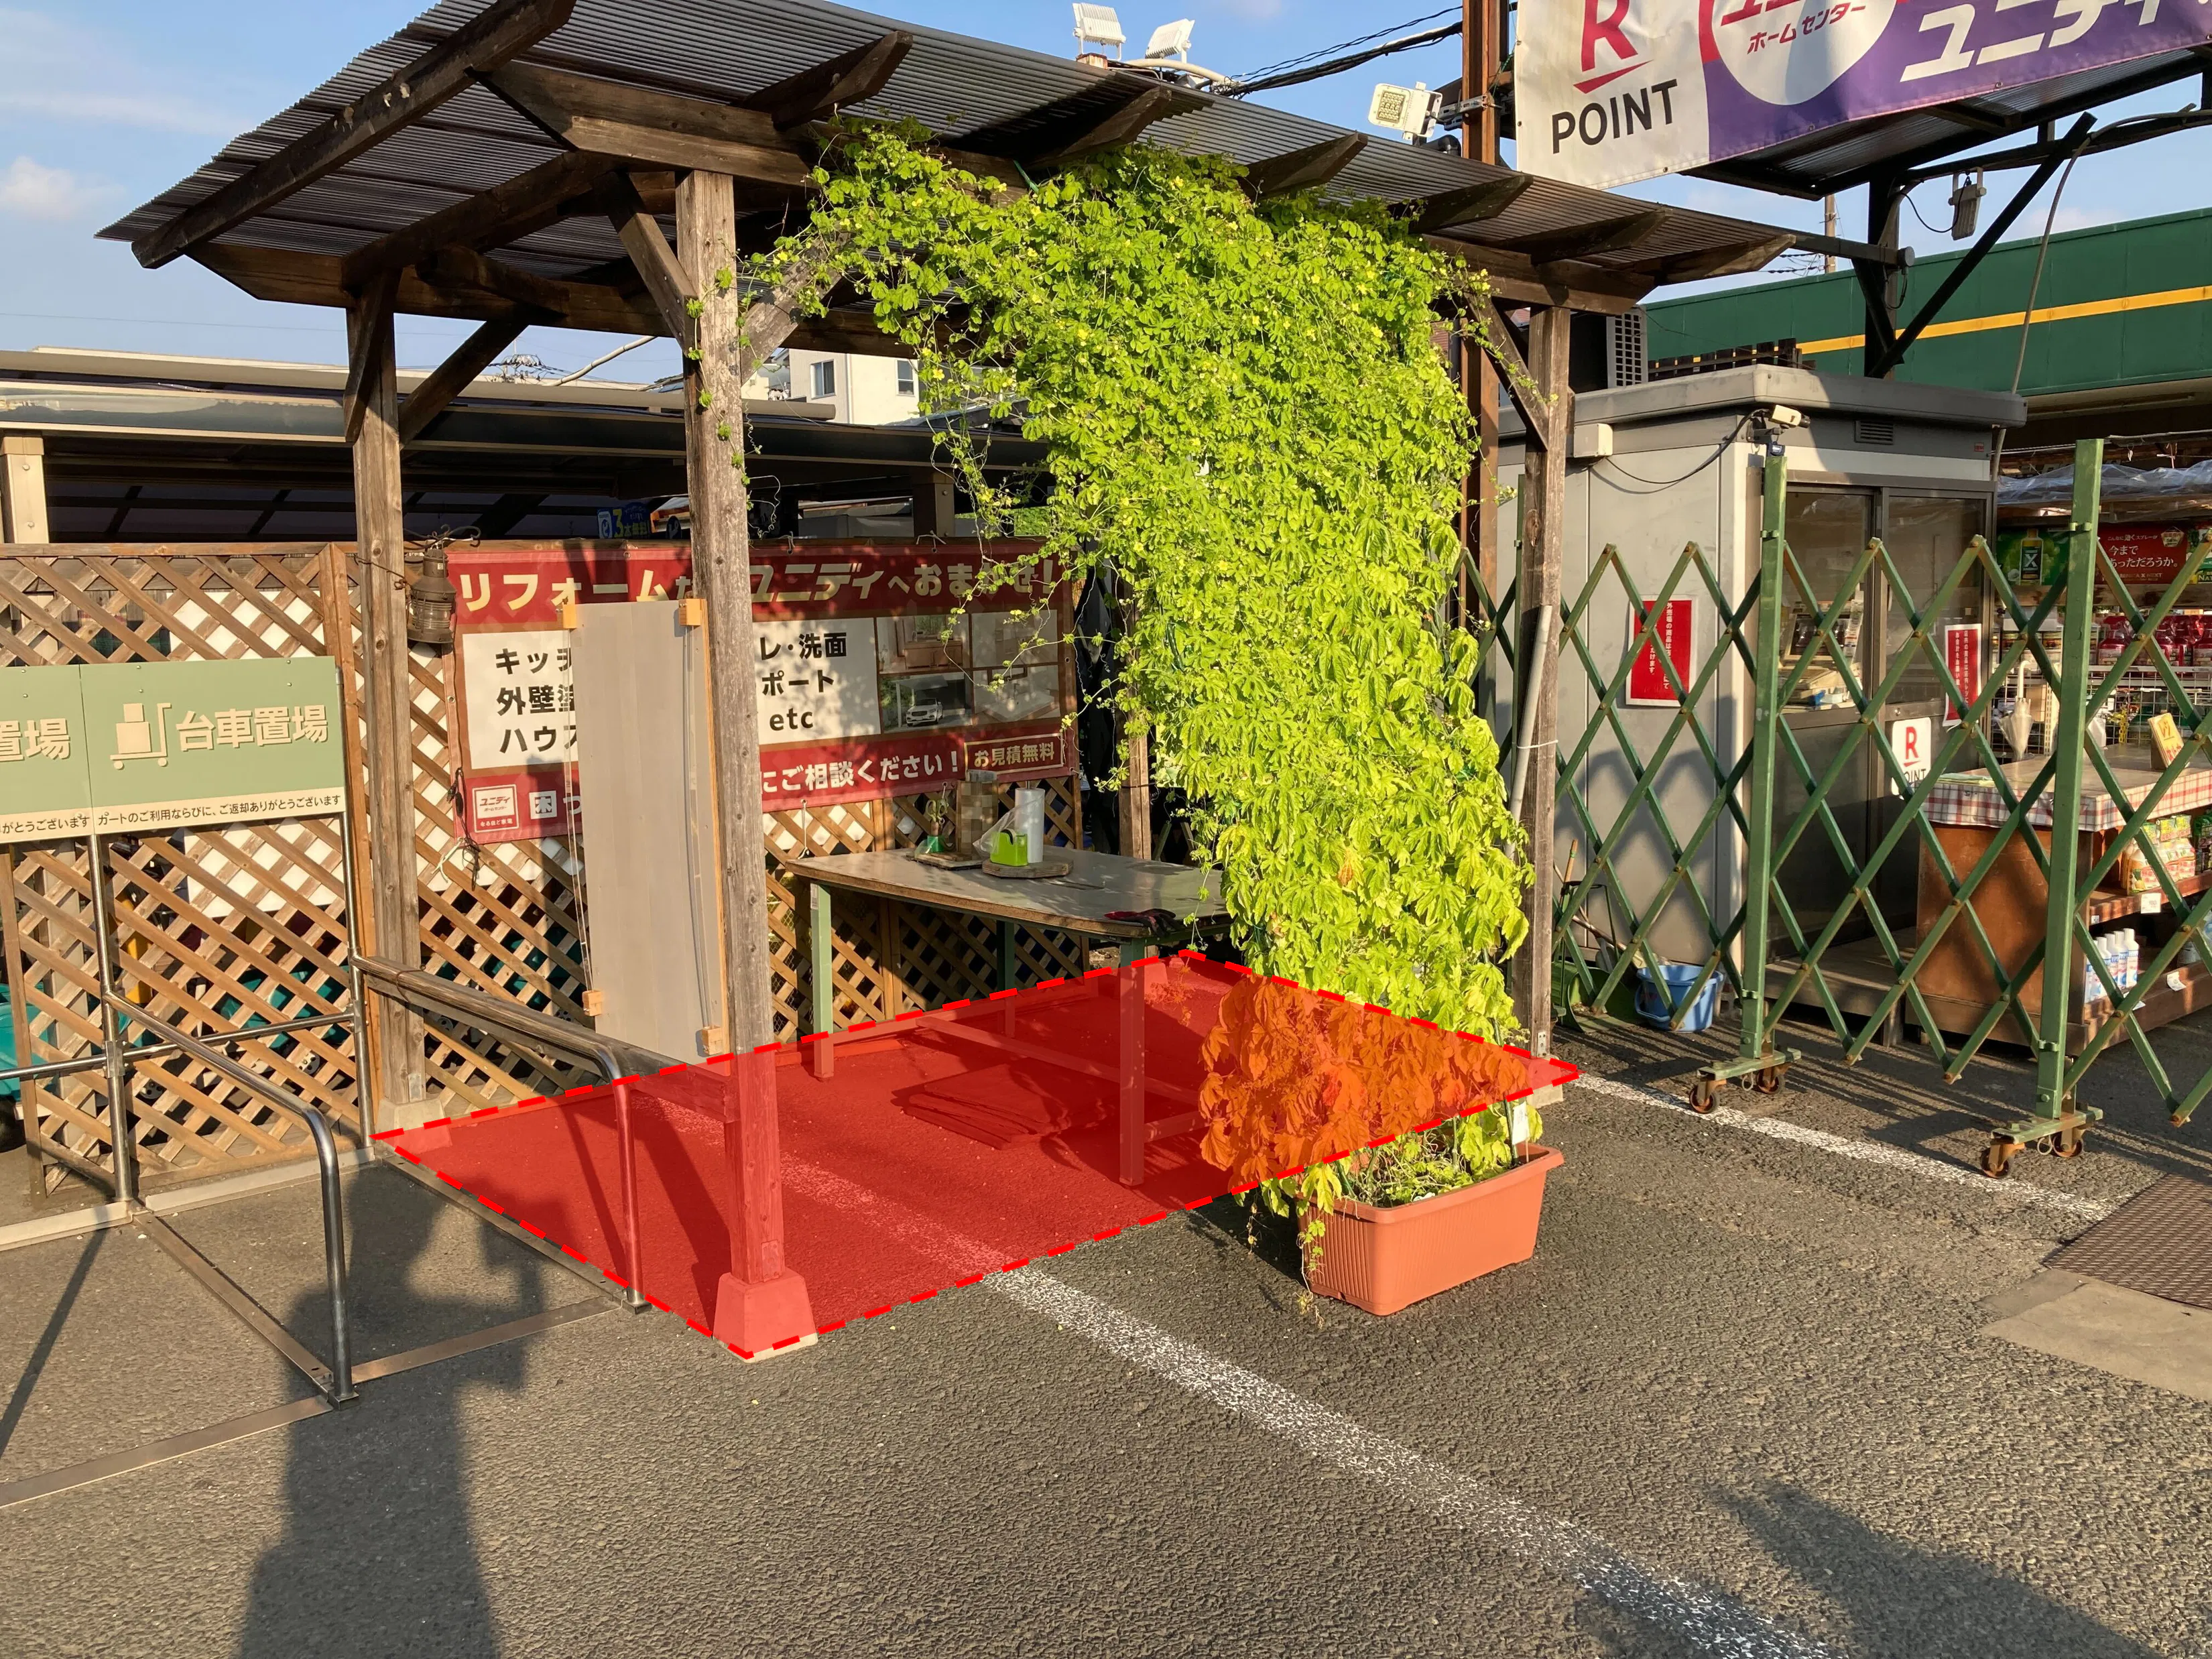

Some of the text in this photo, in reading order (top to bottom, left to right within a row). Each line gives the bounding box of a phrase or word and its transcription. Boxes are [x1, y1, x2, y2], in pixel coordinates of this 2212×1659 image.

[1747, 2, 1866, 54] ホームセンター
[1552, 78, 1678, 155] POINT
[2109, 545, 2139, 556] 今まで
[176, 704, 328, 751] 台車置場
[769, 707, 814, 732] etc
[974, 741, 1055, 768] お見積無料
[1905, 726, 1919, 760] R
[1904, 768, 1926, 783] OINT
[479, 796, 511, 806] ユニディ
[0, 815, 90, 835] がとうございます
